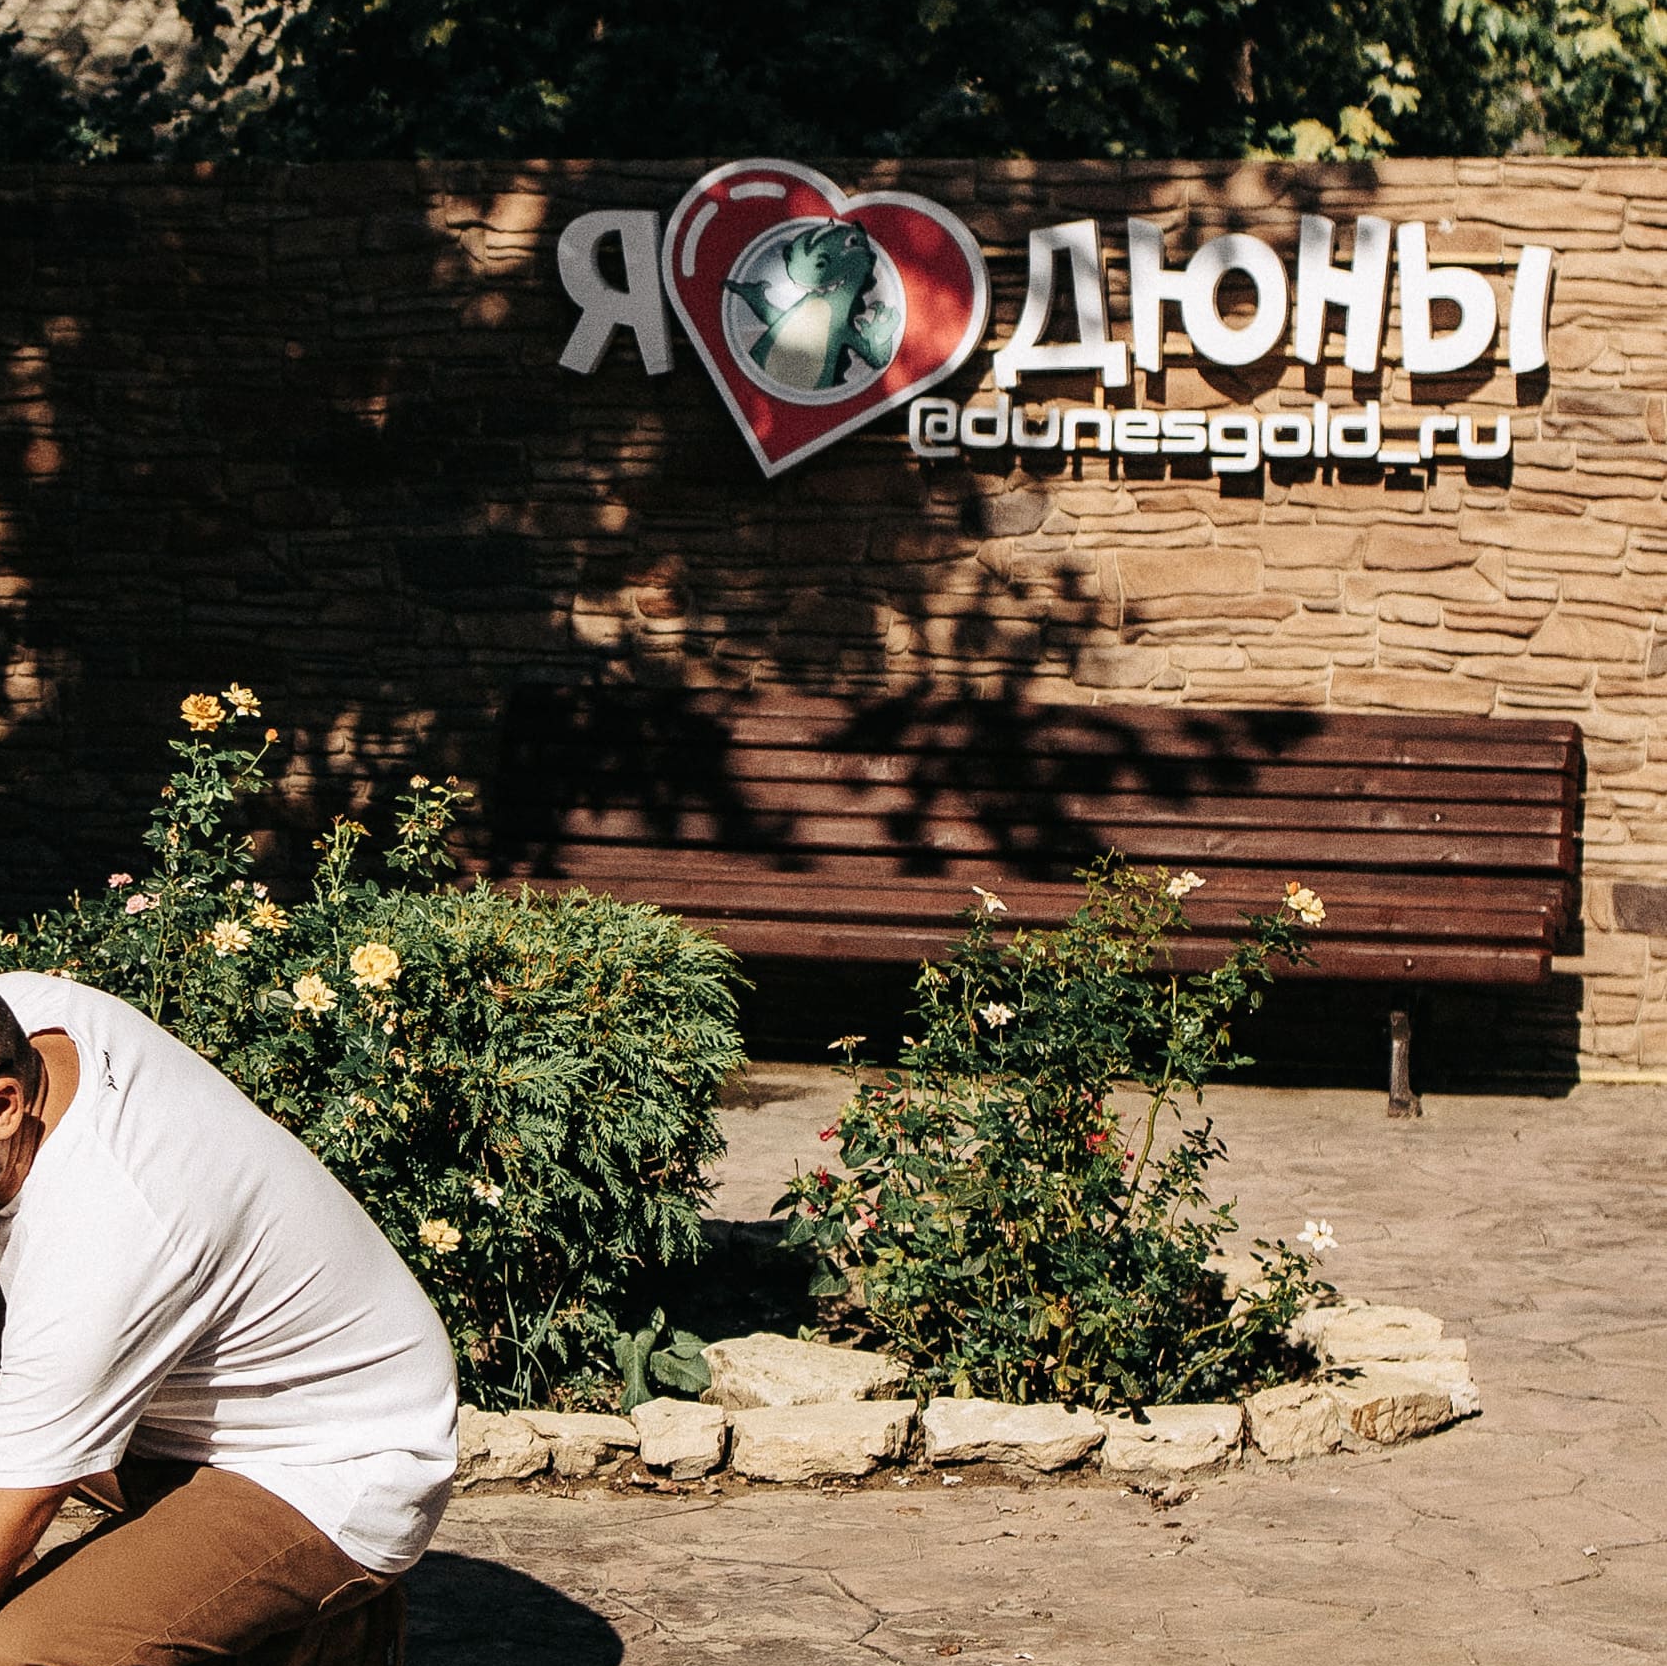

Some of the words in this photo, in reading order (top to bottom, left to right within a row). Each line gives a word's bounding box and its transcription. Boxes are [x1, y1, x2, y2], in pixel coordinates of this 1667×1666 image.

[556, 208, 675, 377] Я
[992, 213, 1556, 389] ДЮНЫ
[907, 393, 1513, 473] @dunesgold_ru
